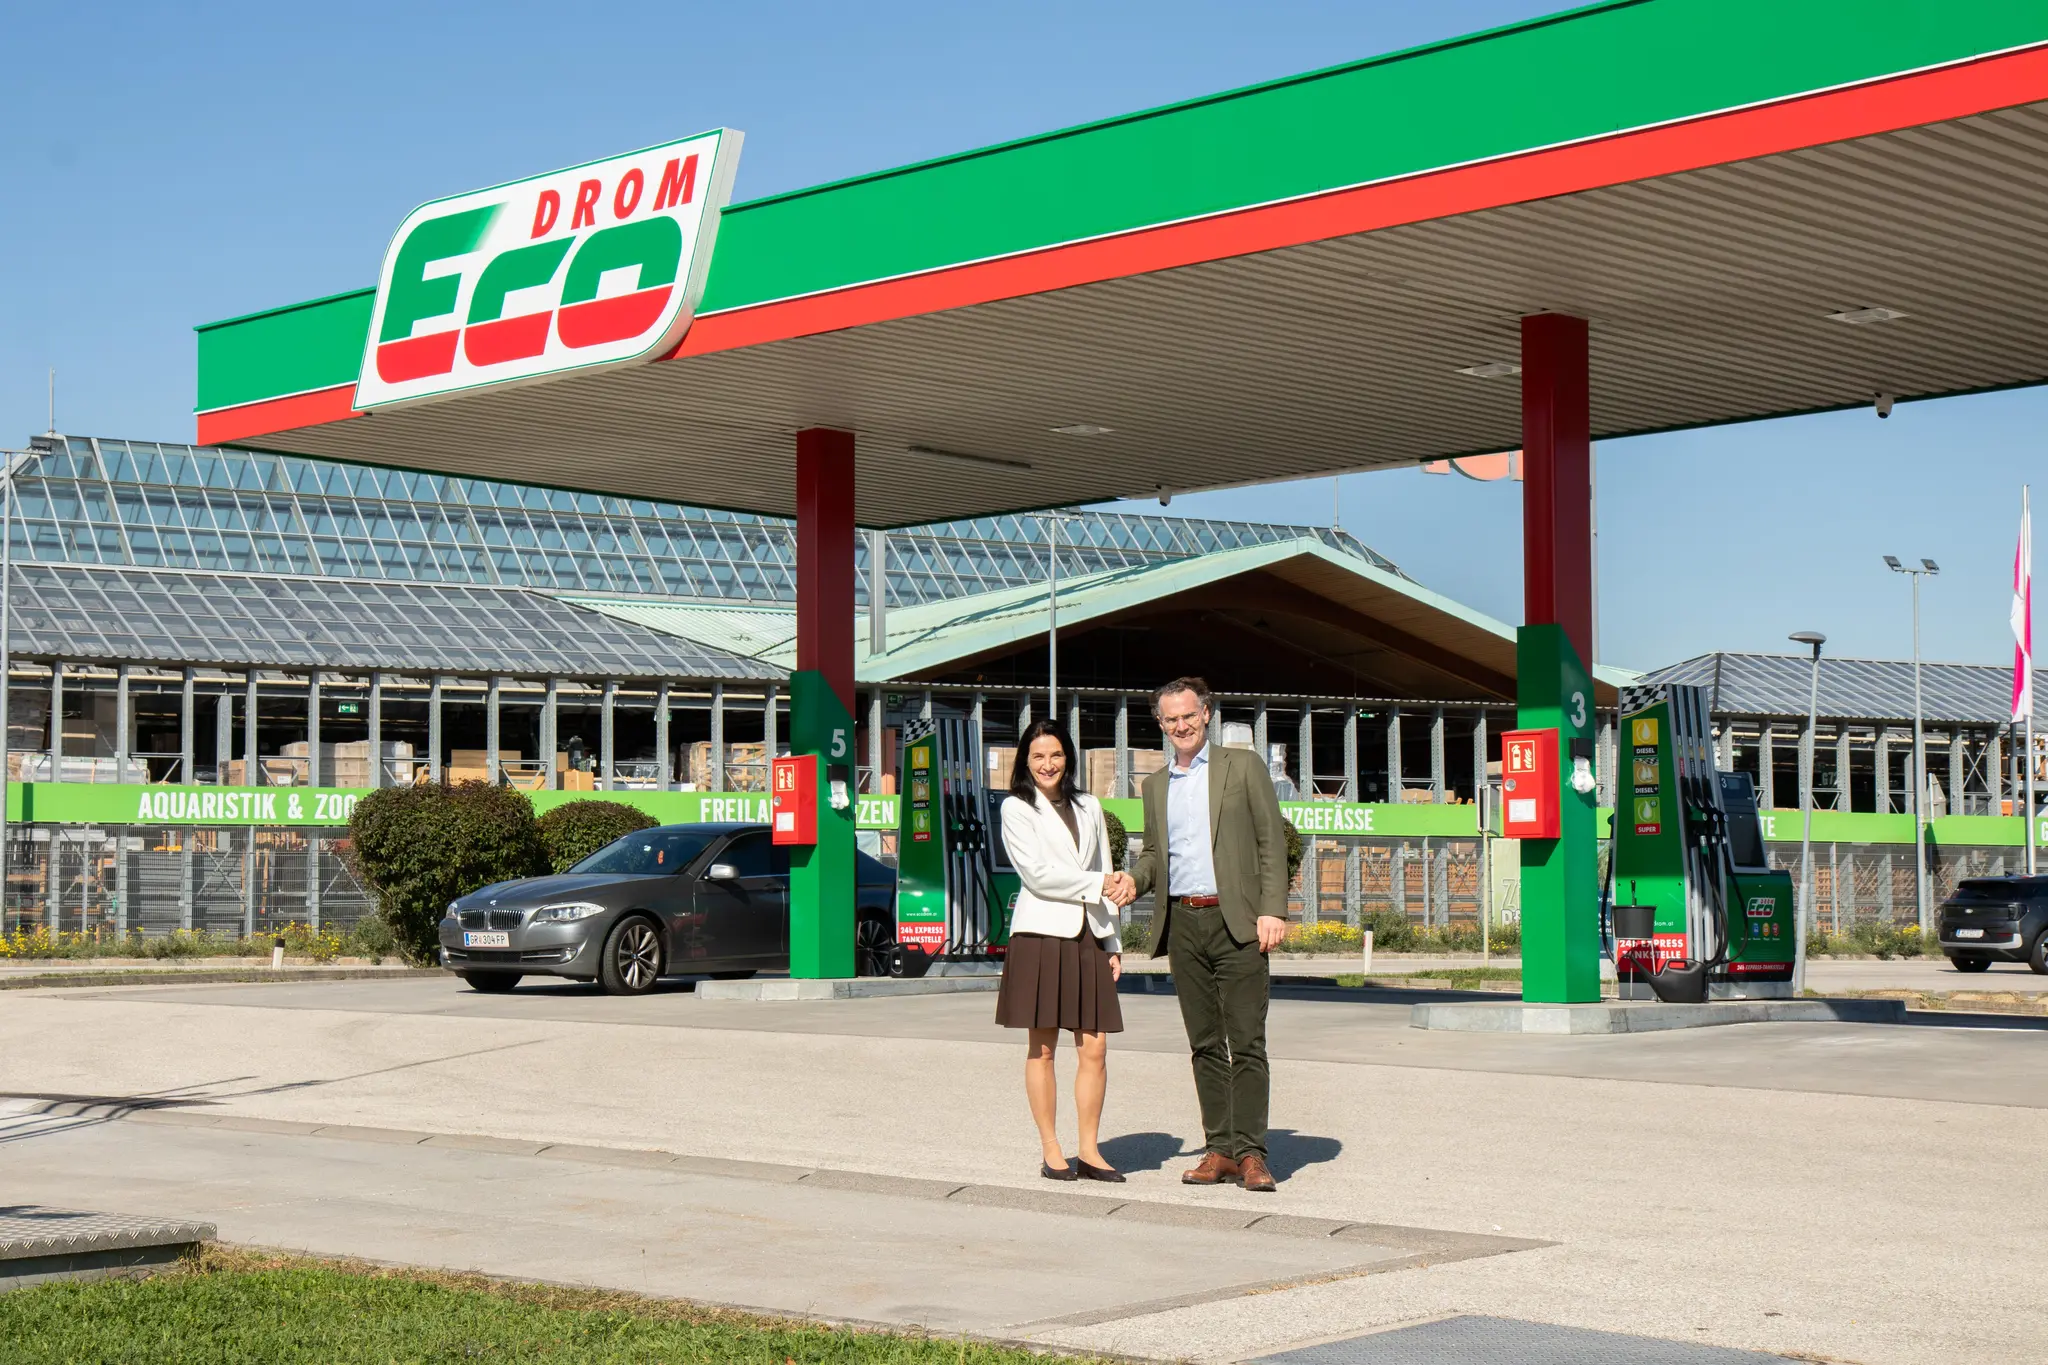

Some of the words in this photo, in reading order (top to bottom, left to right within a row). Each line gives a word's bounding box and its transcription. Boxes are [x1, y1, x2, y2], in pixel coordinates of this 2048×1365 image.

[531, 153, 699, 239] DROM
[1571, 691, 1586, 728] 3
[830, 728, 846, 758] 5
[1721, 777, 1728, 788] 3
[138, 791, 277, 820] AQUARISTIK
[287, 793, 304, 820] &
[989, 794, 996, 804] 5
[856, 800, 895, 824] ZEN
[900, 926, 913, 934] 24h
[914, 926, 944, 934] EXPRESS
[1641, 939, 1684, 948] EXPRESS
[1621, 950, 1681, 959] TNKSTELLE
